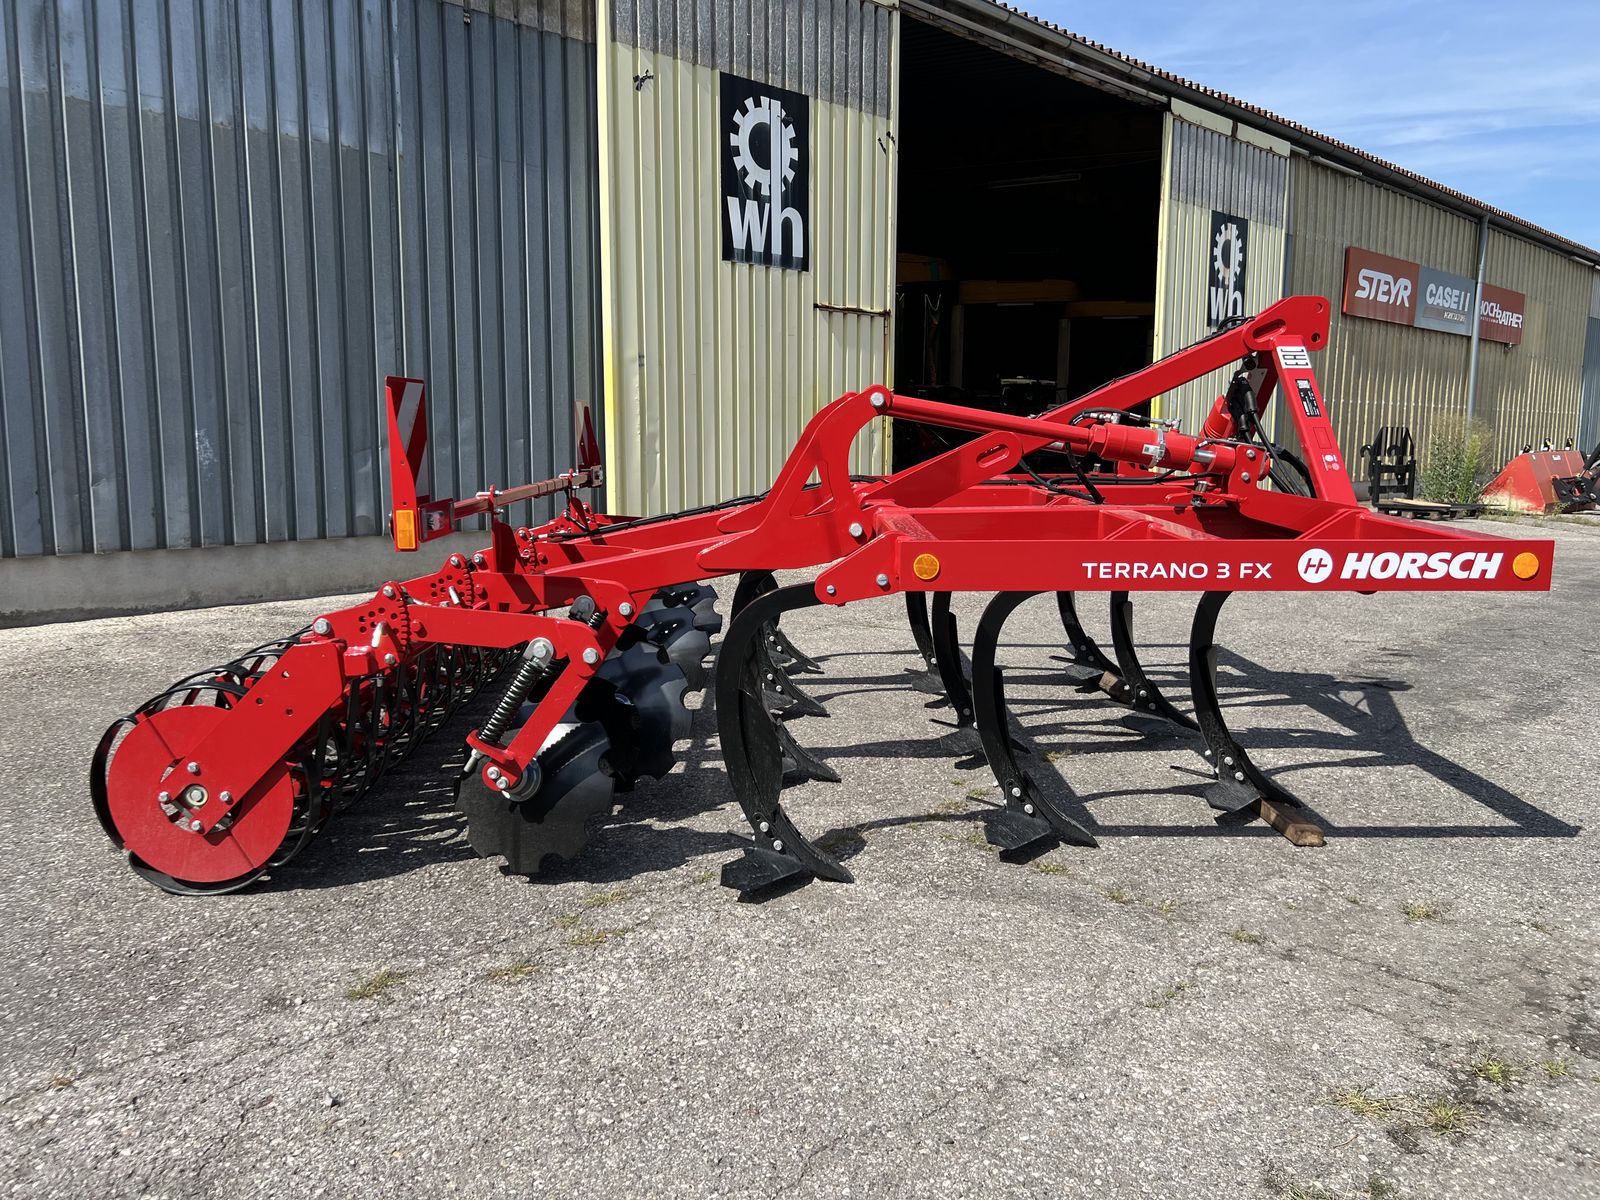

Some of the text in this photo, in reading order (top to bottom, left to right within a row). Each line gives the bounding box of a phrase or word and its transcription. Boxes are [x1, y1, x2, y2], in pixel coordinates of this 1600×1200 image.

[1355, 268, 1412, 307] STEYR
[1426, 283, 1460, 310] CASE
[1082, 562, 1272, 579] TERRANO 3 FX
[1340, 552, 1504, 580] HORSCH
